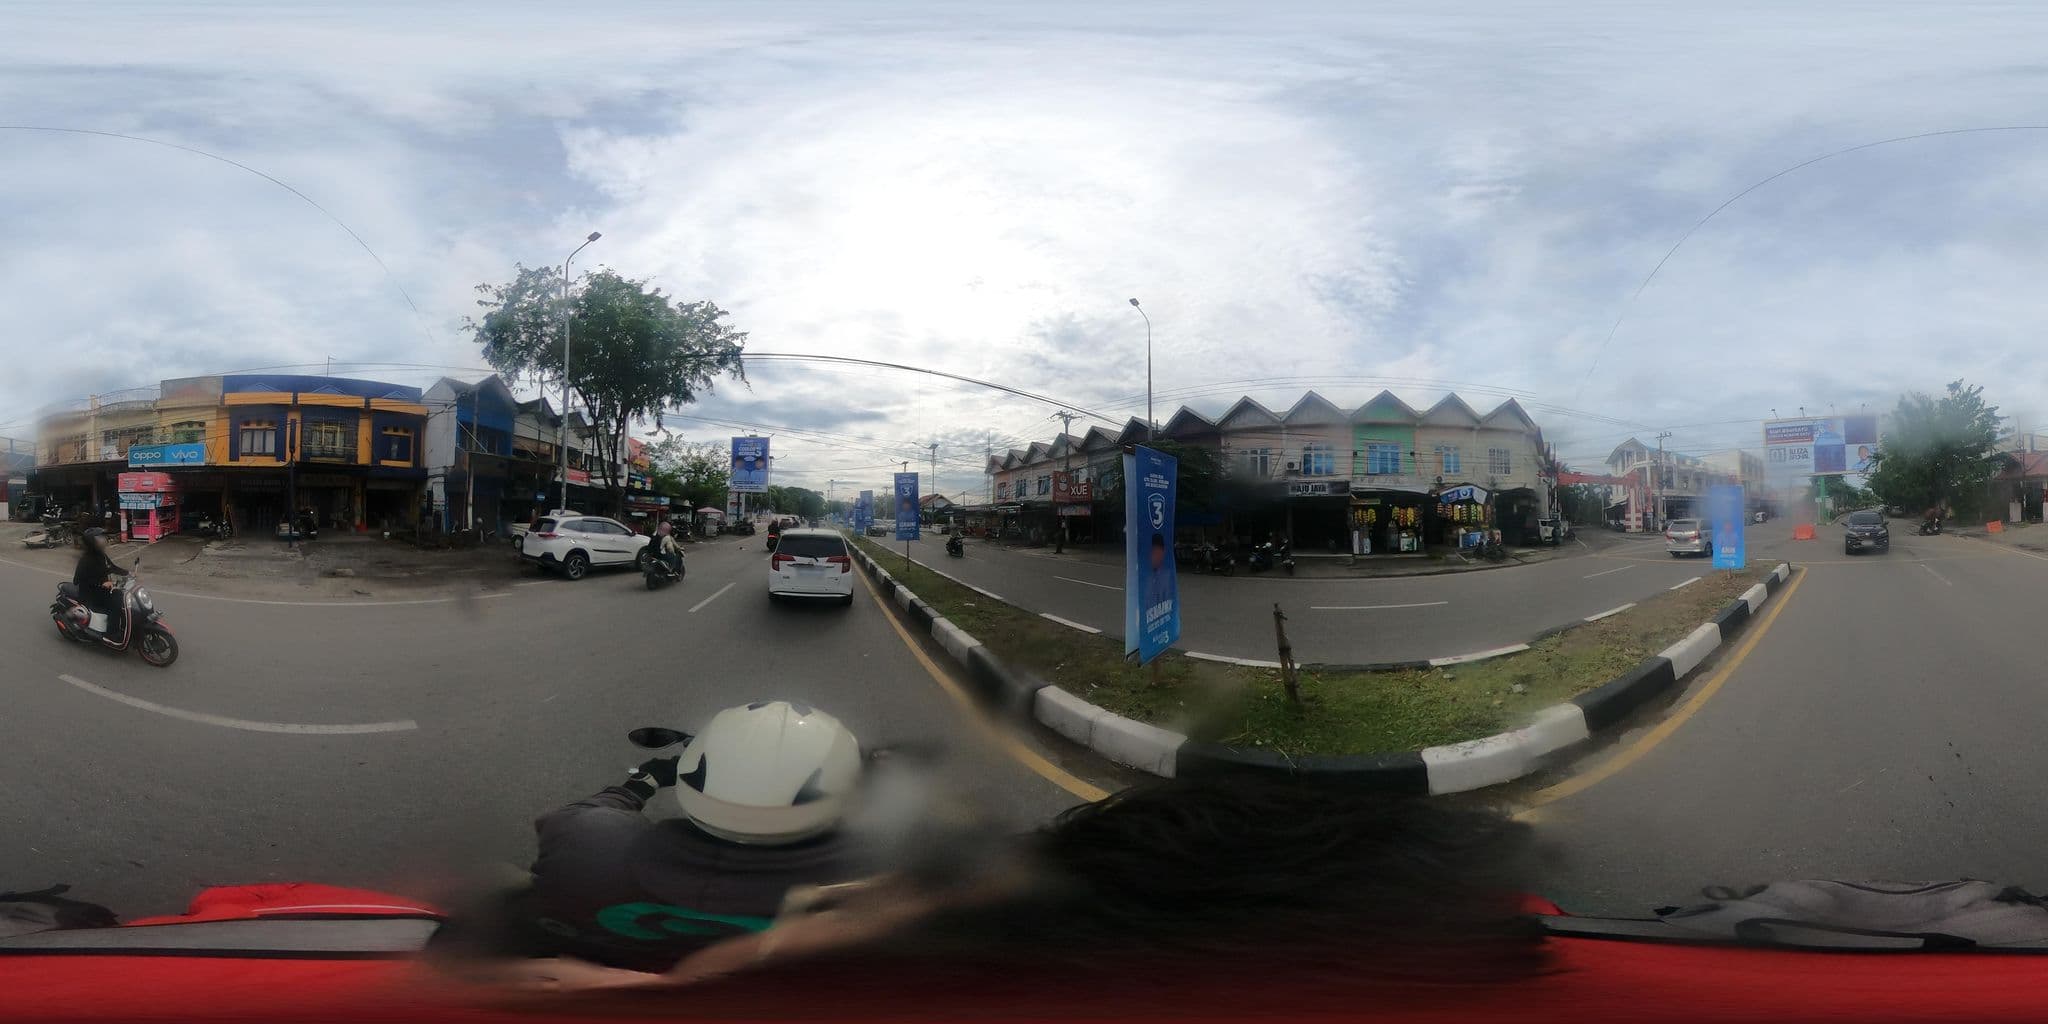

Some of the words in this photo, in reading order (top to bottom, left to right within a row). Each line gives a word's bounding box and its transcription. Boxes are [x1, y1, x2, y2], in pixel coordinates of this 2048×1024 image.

[133, 452, 161, 461] oppo
[171, 450, 198, 459] vivo
[1152, 501, 1162, 525] 3
